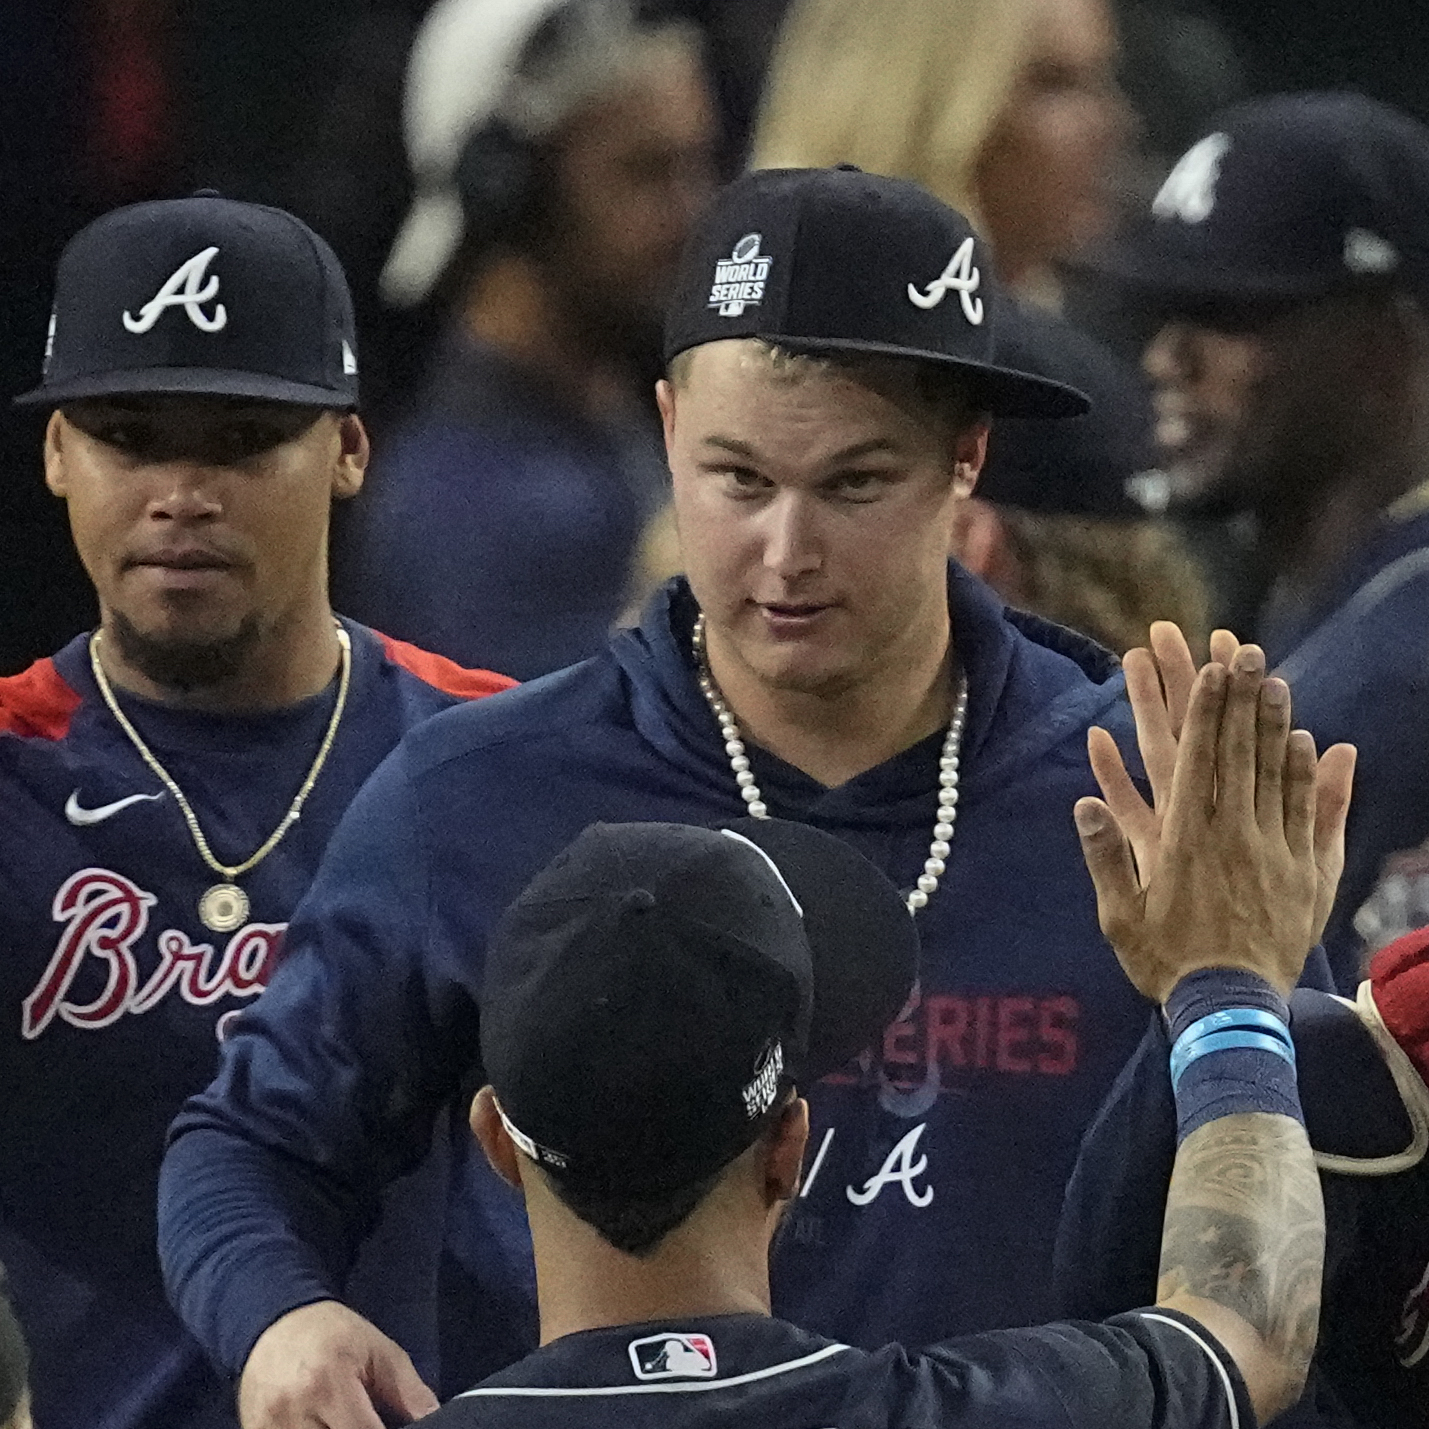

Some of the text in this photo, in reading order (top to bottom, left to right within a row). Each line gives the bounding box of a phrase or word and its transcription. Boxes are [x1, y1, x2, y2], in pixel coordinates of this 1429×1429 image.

[123, 246, 226, 334] A
[708, 281, 765, 303] SERIES
[714, 262, 769, 284] WORLD
[908, 236, 984, 326] A
[22, 867, 290, 1040] Bra
[882, 994, 1081, 1076] ERIES
[846, 1122, 935, 1208] A
